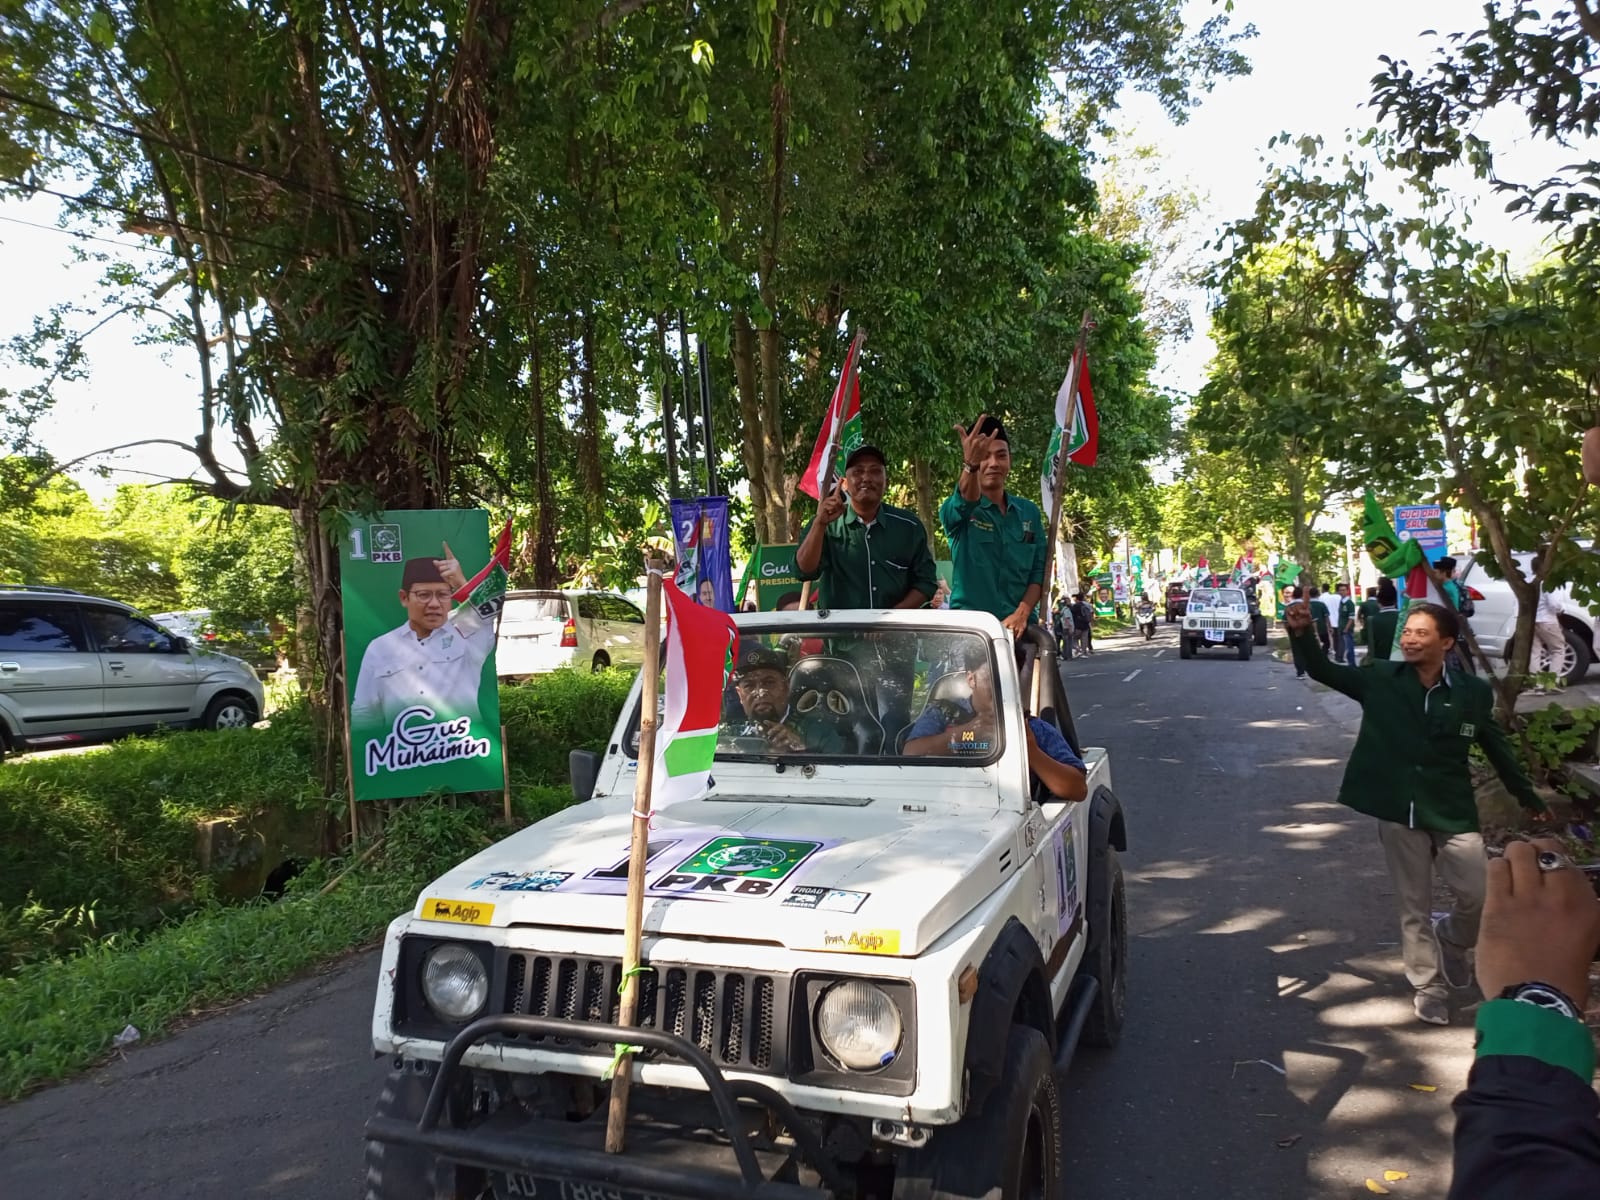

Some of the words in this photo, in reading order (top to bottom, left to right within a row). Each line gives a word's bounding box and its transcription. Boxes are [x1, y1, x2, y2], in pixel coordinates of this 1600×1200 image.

[681, 521, 693, 542] 2
[350, 528, 367, 560] 1
[372, 552, 402, 562] PKB
[396, 707, 467, 746] Gus
[368, 736, 487, 773] Muhaimin
[655, 875, 774, 895] PKB
[452, 904, 481, 922] Agip
[848, 931, 884, 950] Agip
